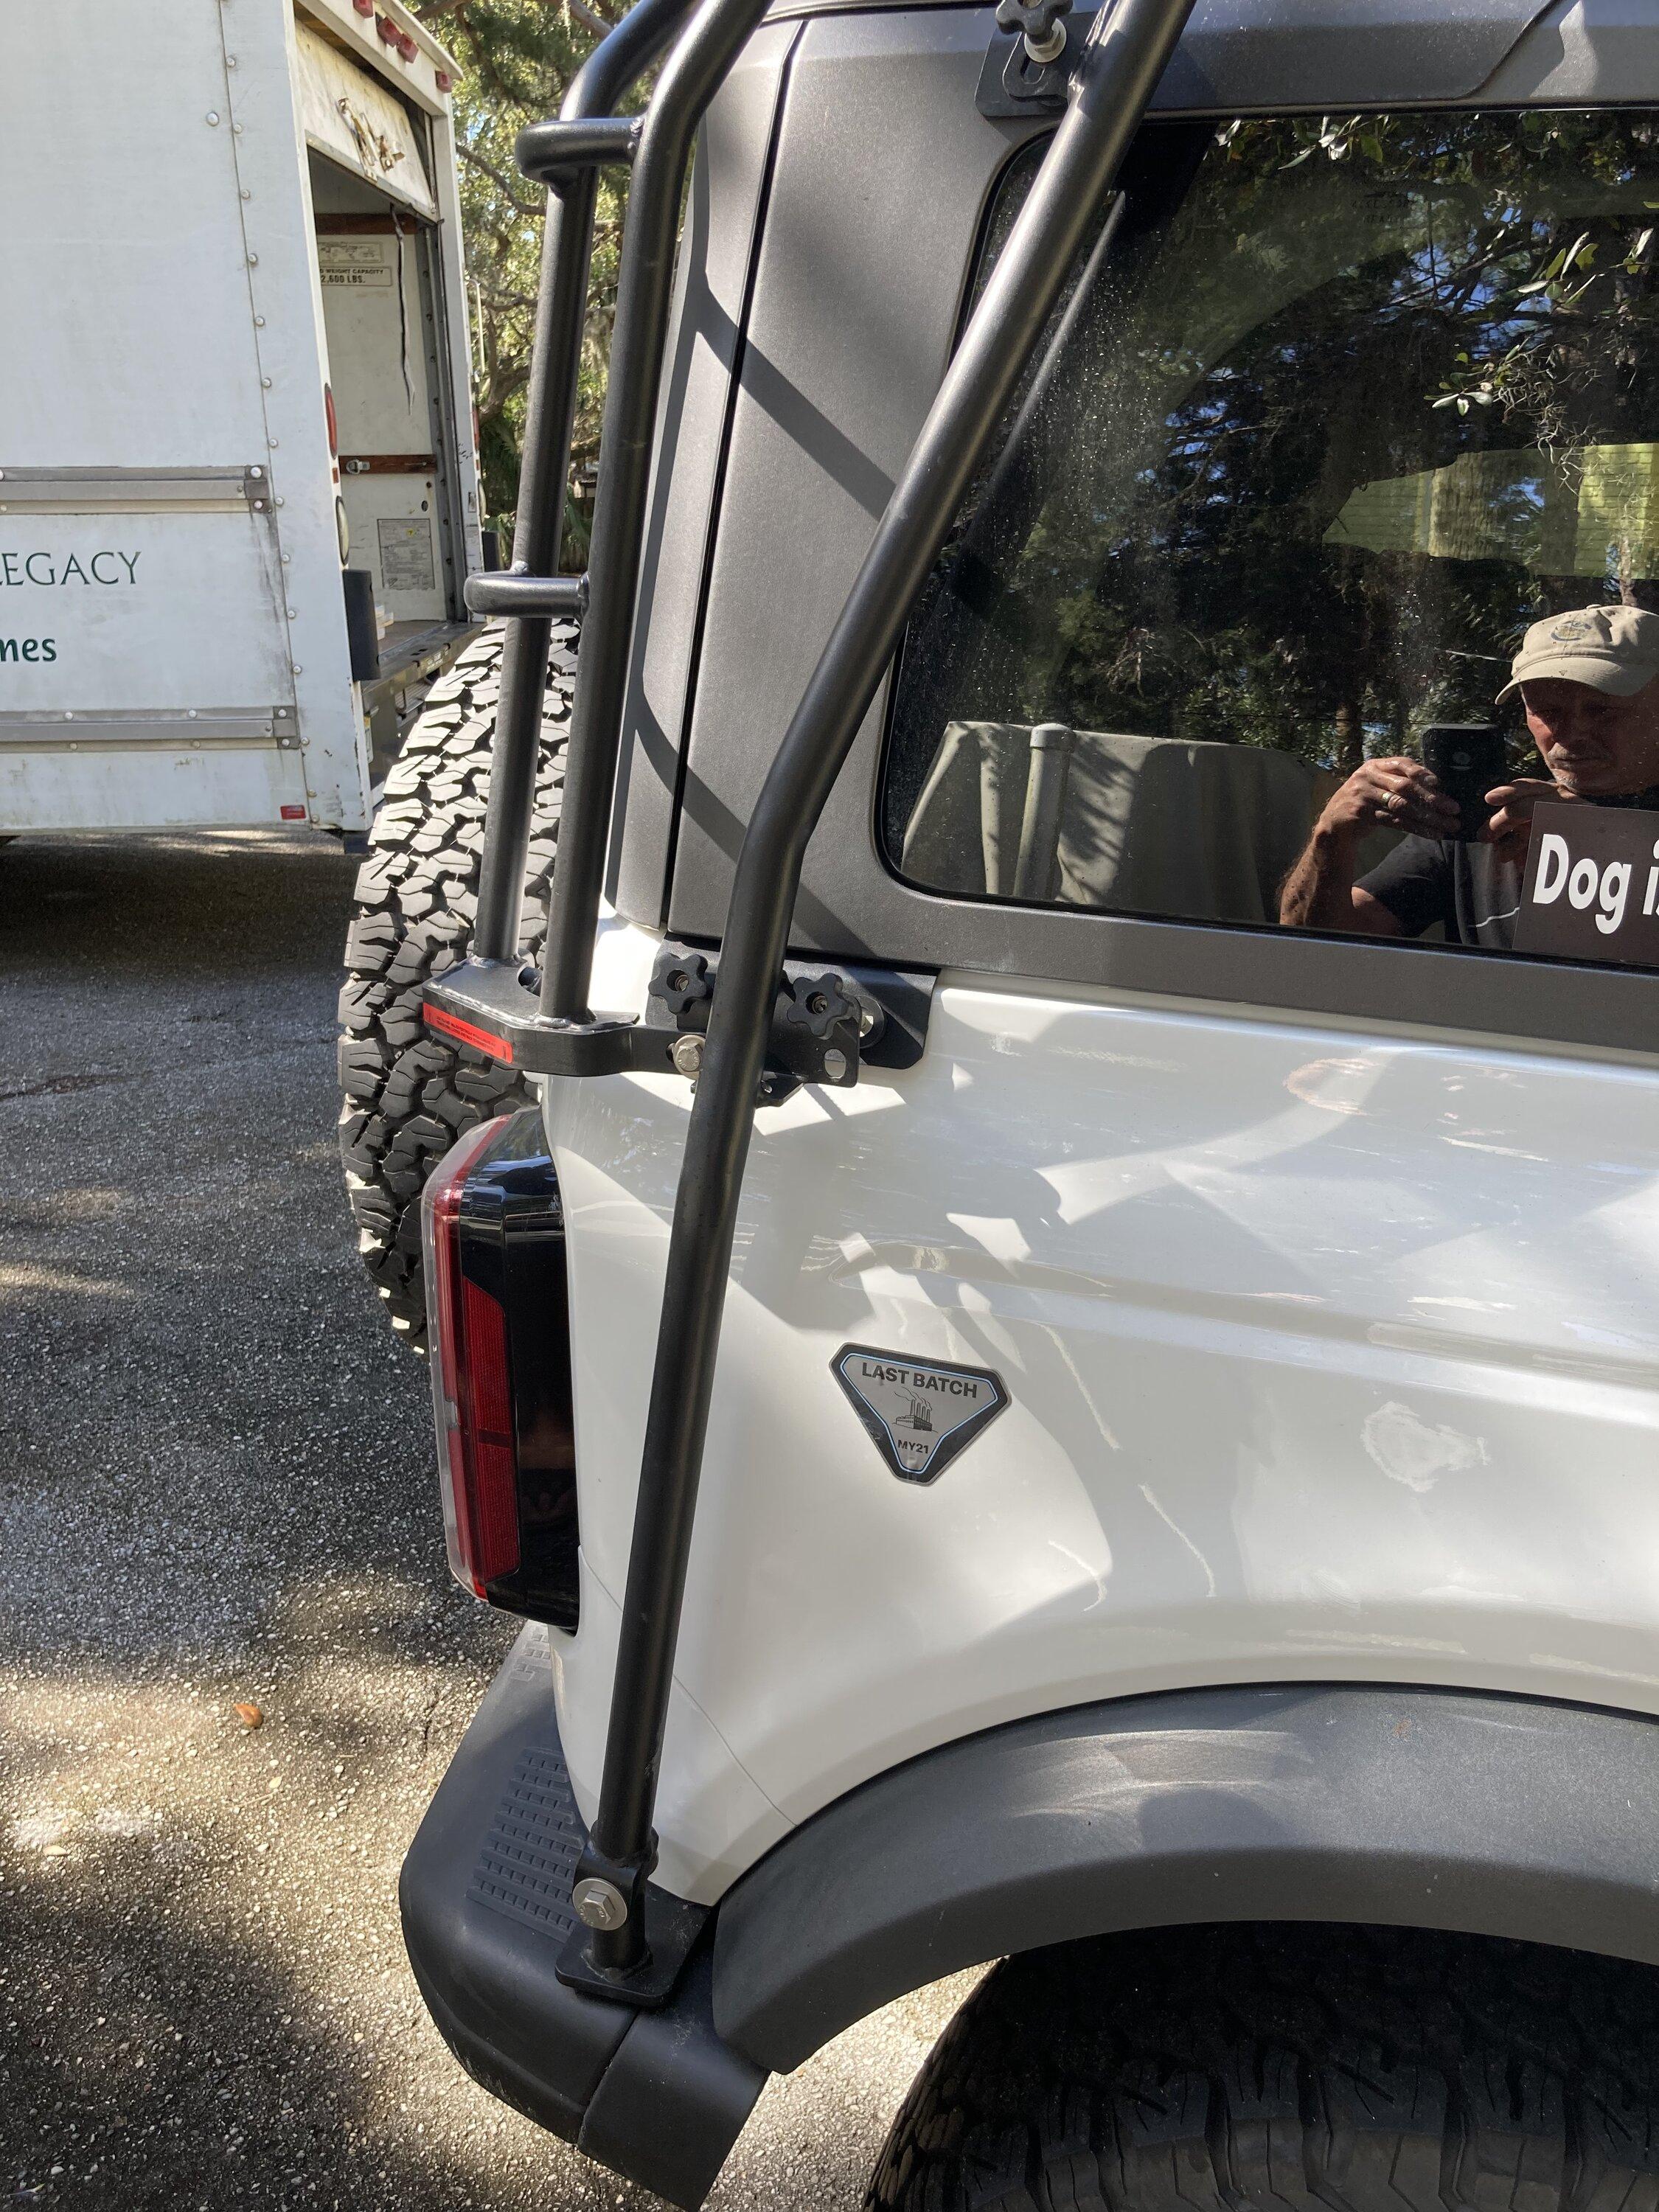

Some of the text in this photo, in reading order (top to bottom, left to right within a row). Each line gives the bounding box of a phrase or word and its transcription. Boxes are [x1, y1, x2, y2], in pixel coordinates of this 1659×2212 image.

[0, 551, 142, 585] EGACY
[1533, 833, 1659, 934] Dog i
[862, 1362, 978, 1399] LAST BATCH
[897, 1439, 929, 1454] MY21
